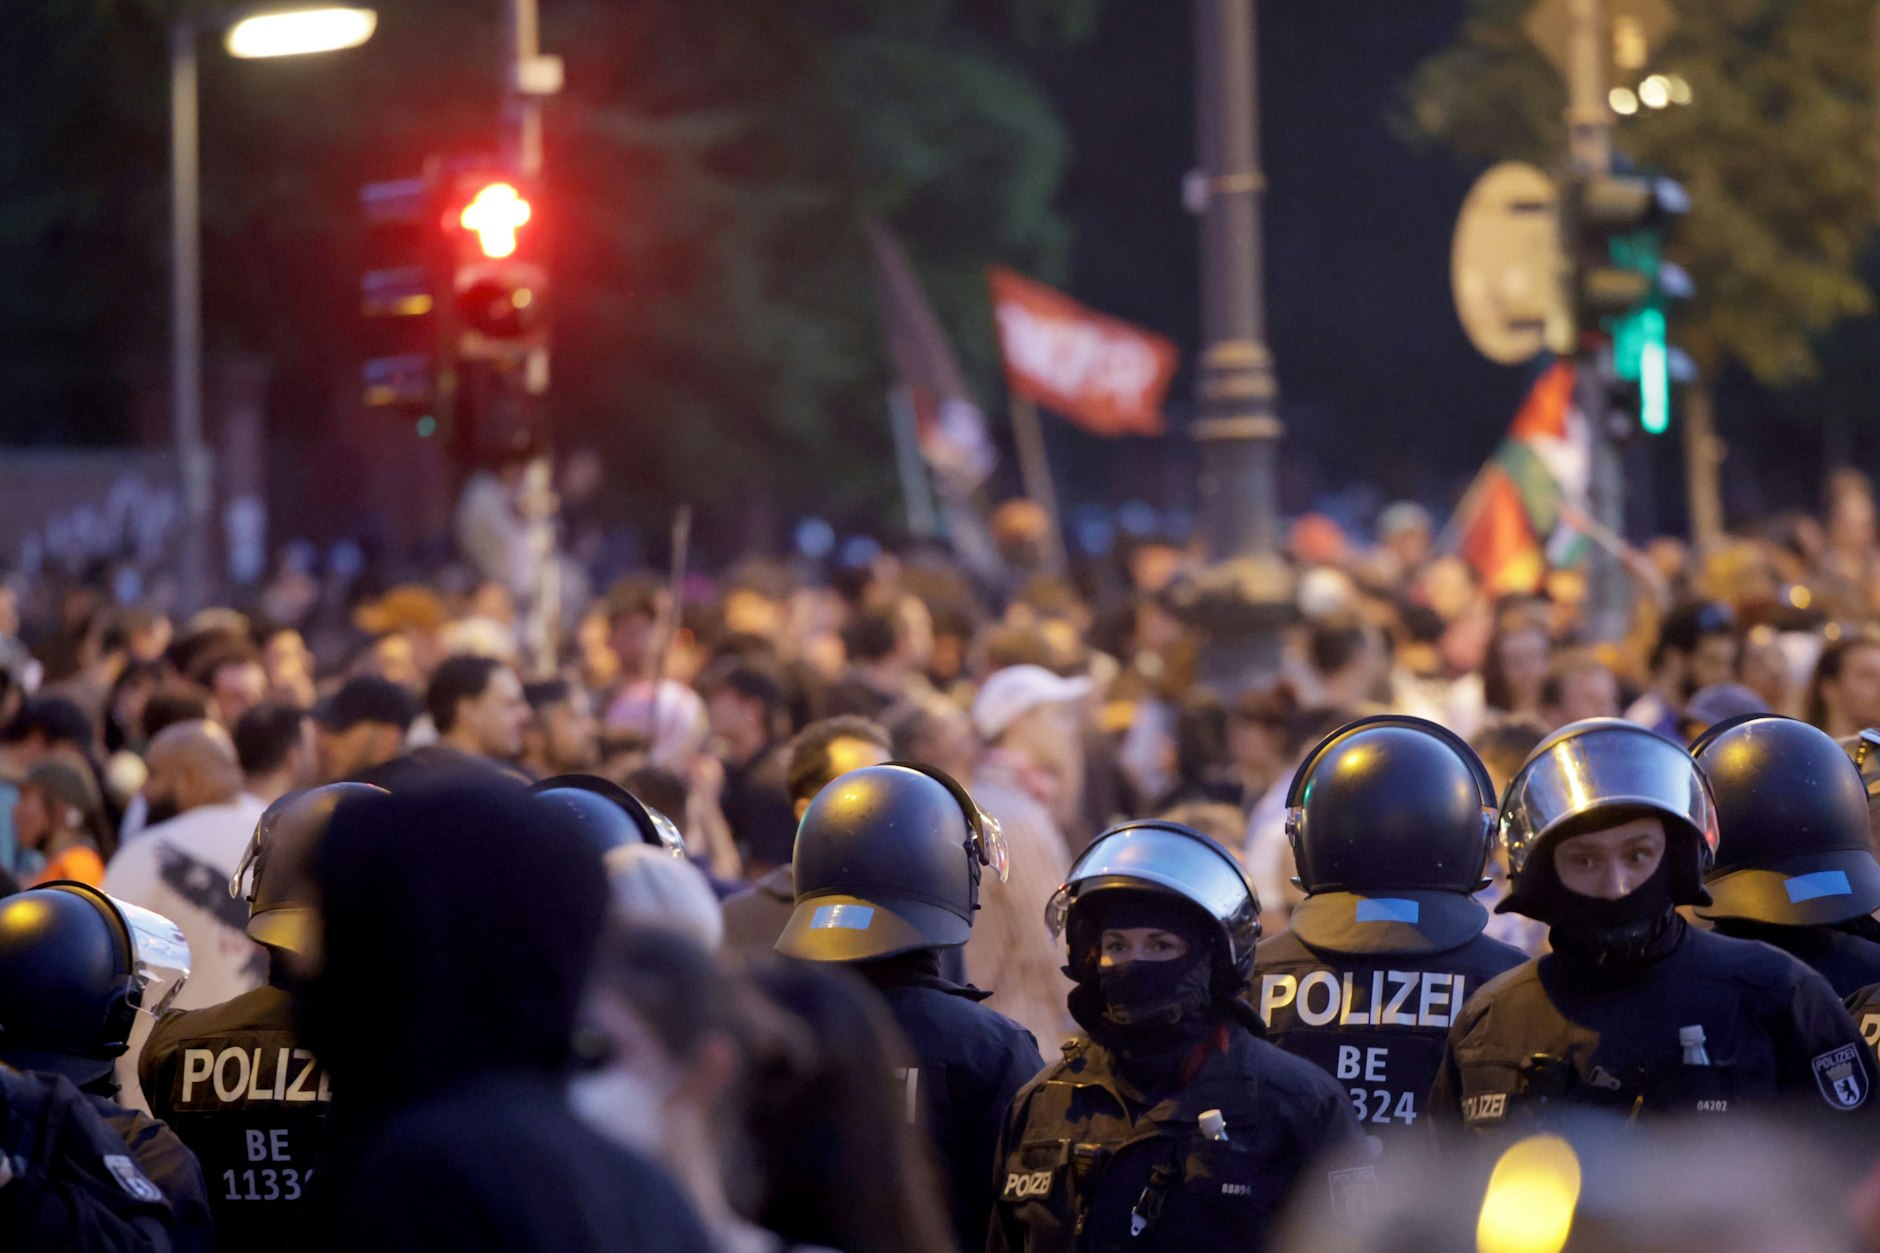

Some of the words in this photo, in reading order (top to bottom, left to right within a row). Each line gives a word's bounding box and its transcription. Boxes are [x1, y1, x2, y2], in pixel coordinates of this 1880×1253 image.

[1260, 970, 1465, 1028] POLIZEI
[1337, 1044, 1388, 1082] BE
[1815, 1047, 1855, 1071] POLIZEI
[1349, 1087, 1417, 1125] 324
[1697, 1100, 1728, 1112] 04202
[245, 1129, 291, 1161] BE
[223, 1168, 313, 1200] 1133
